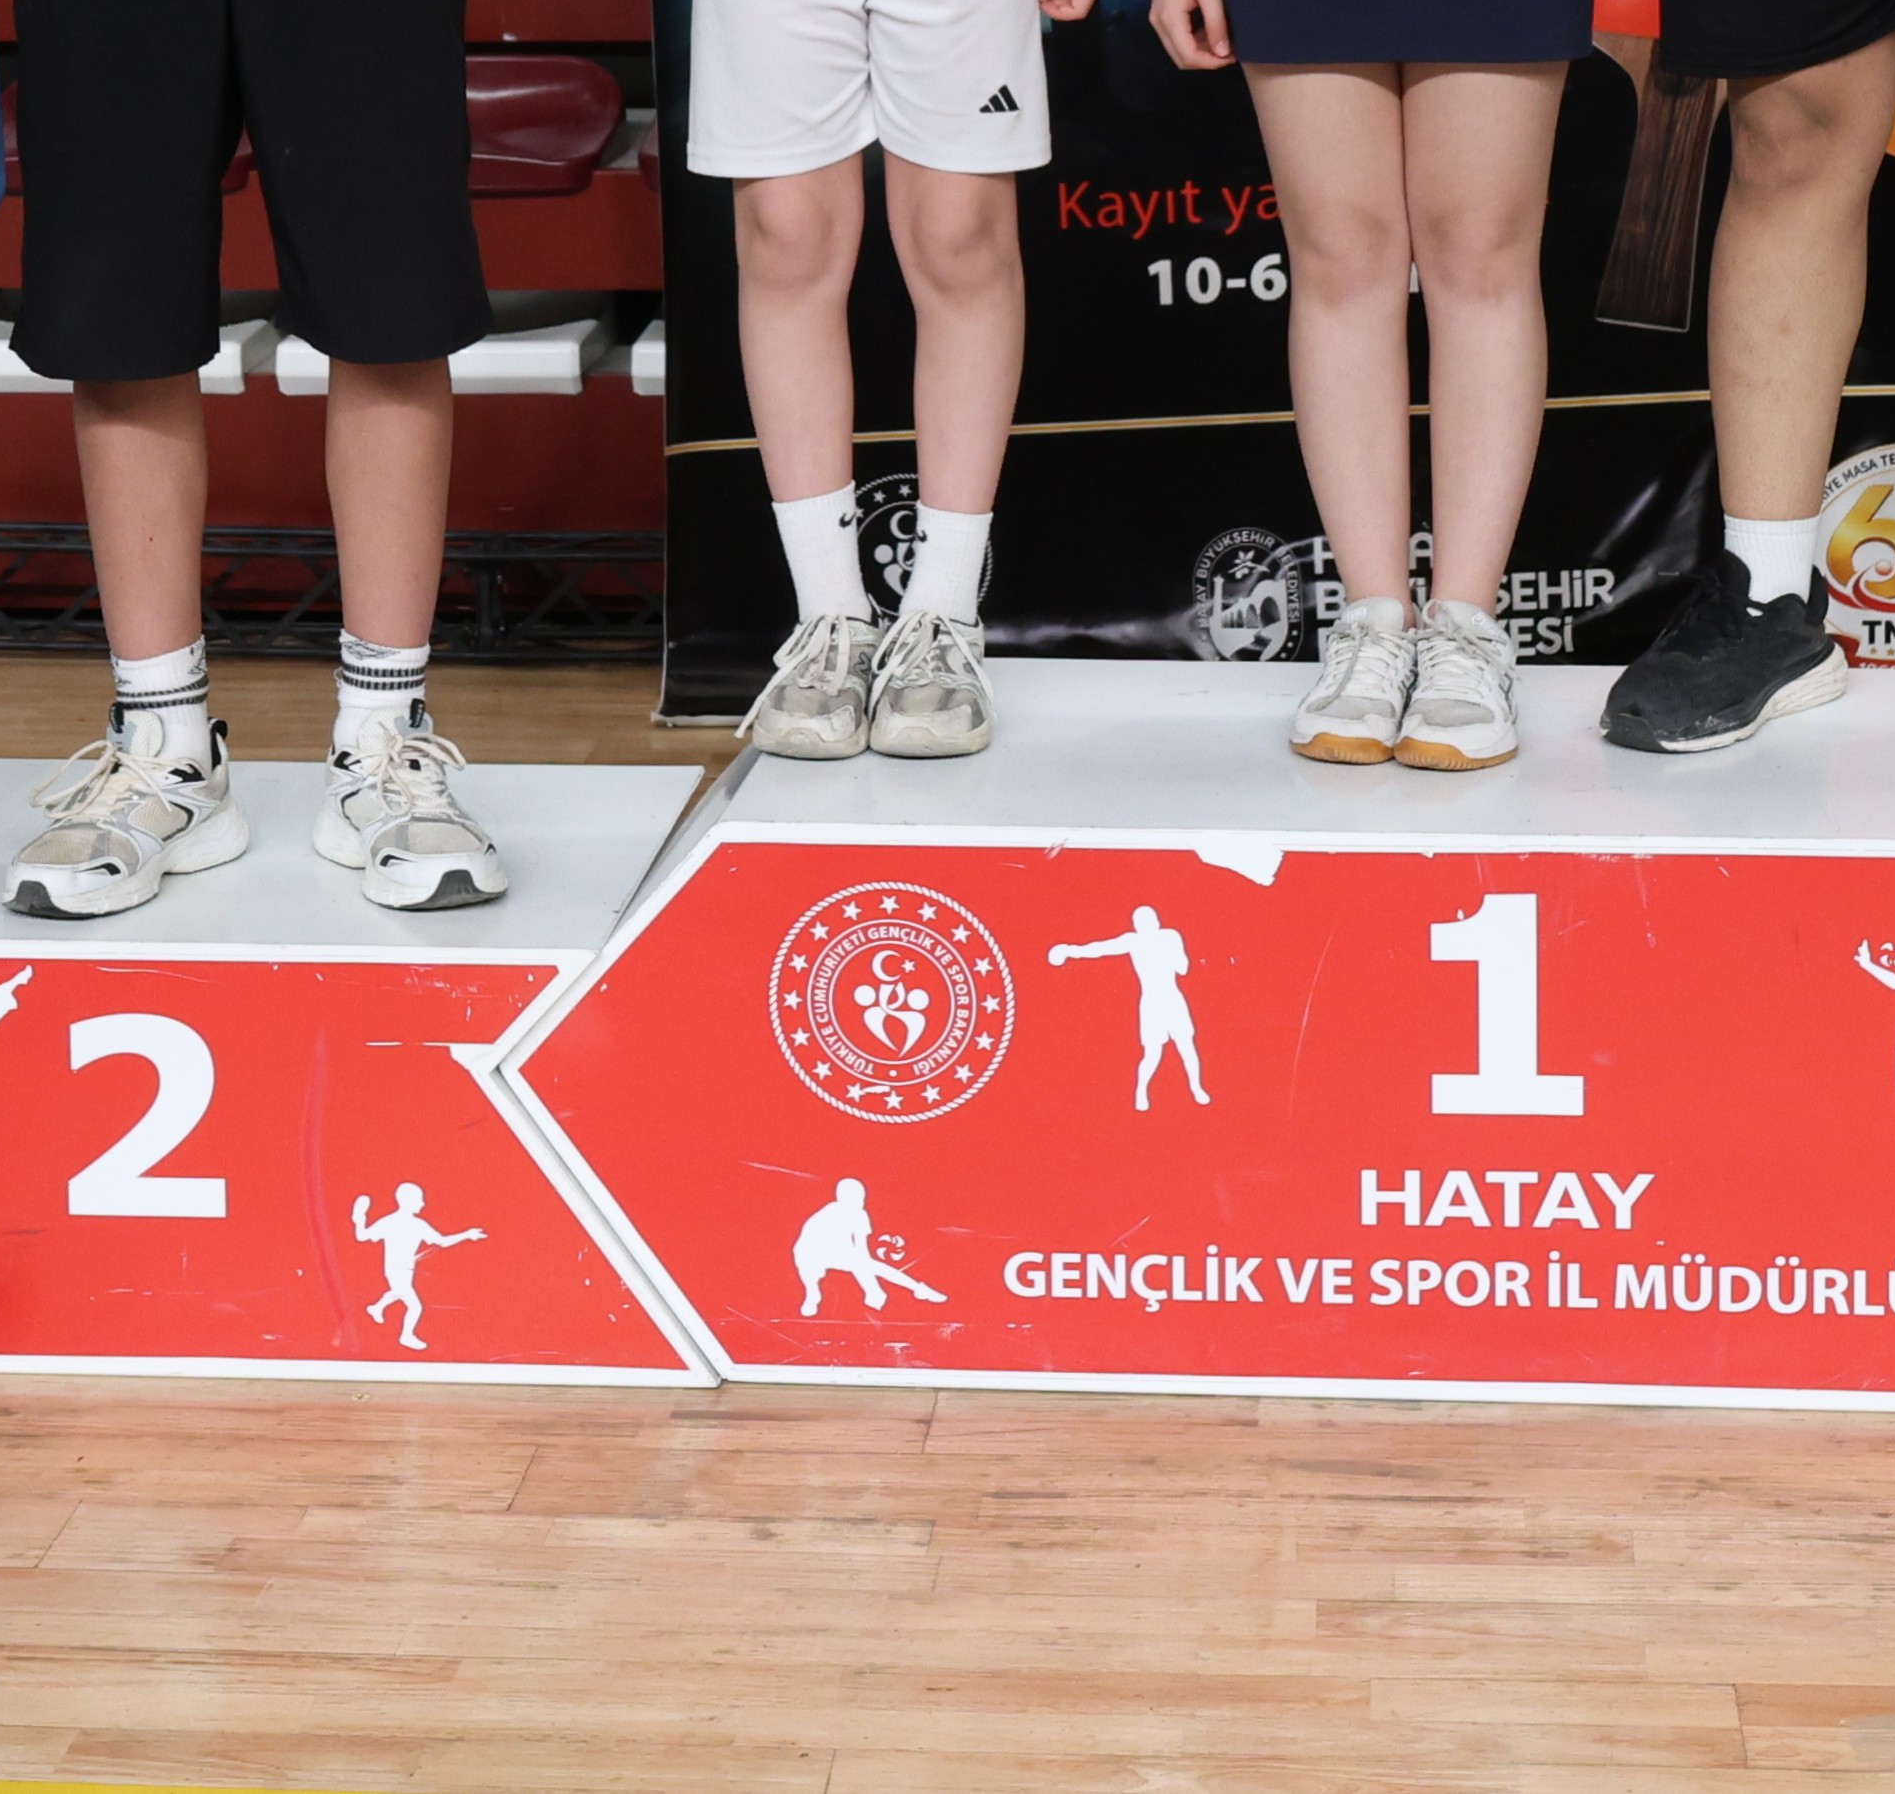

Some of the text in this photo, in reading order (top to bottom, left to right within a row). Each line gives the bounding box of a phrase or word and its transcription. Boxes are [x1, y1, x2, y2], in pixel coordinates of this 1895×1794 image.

[1058, 180, 1203, 240] Kayıt
[1841, 458, 1879, 484] MASA
[814, 926, 970, 1076] TÜRKİYE CUMHURİYETİ GENÇLİK VE SPOR BAKANLIĞI
[1429, 893, 1585, 1117] 1
[67, 1012, 227, 1218] 2
[1360, 1168, 1655, 1230] HATAY
[1003, 1243, 1265, 1313] GENÇLİK
[1275, 1259, 1353, 1305] VE
[1369, 1256, 1531, 1308] SPOR
[1547, 1249, 1598, 1309] İL
